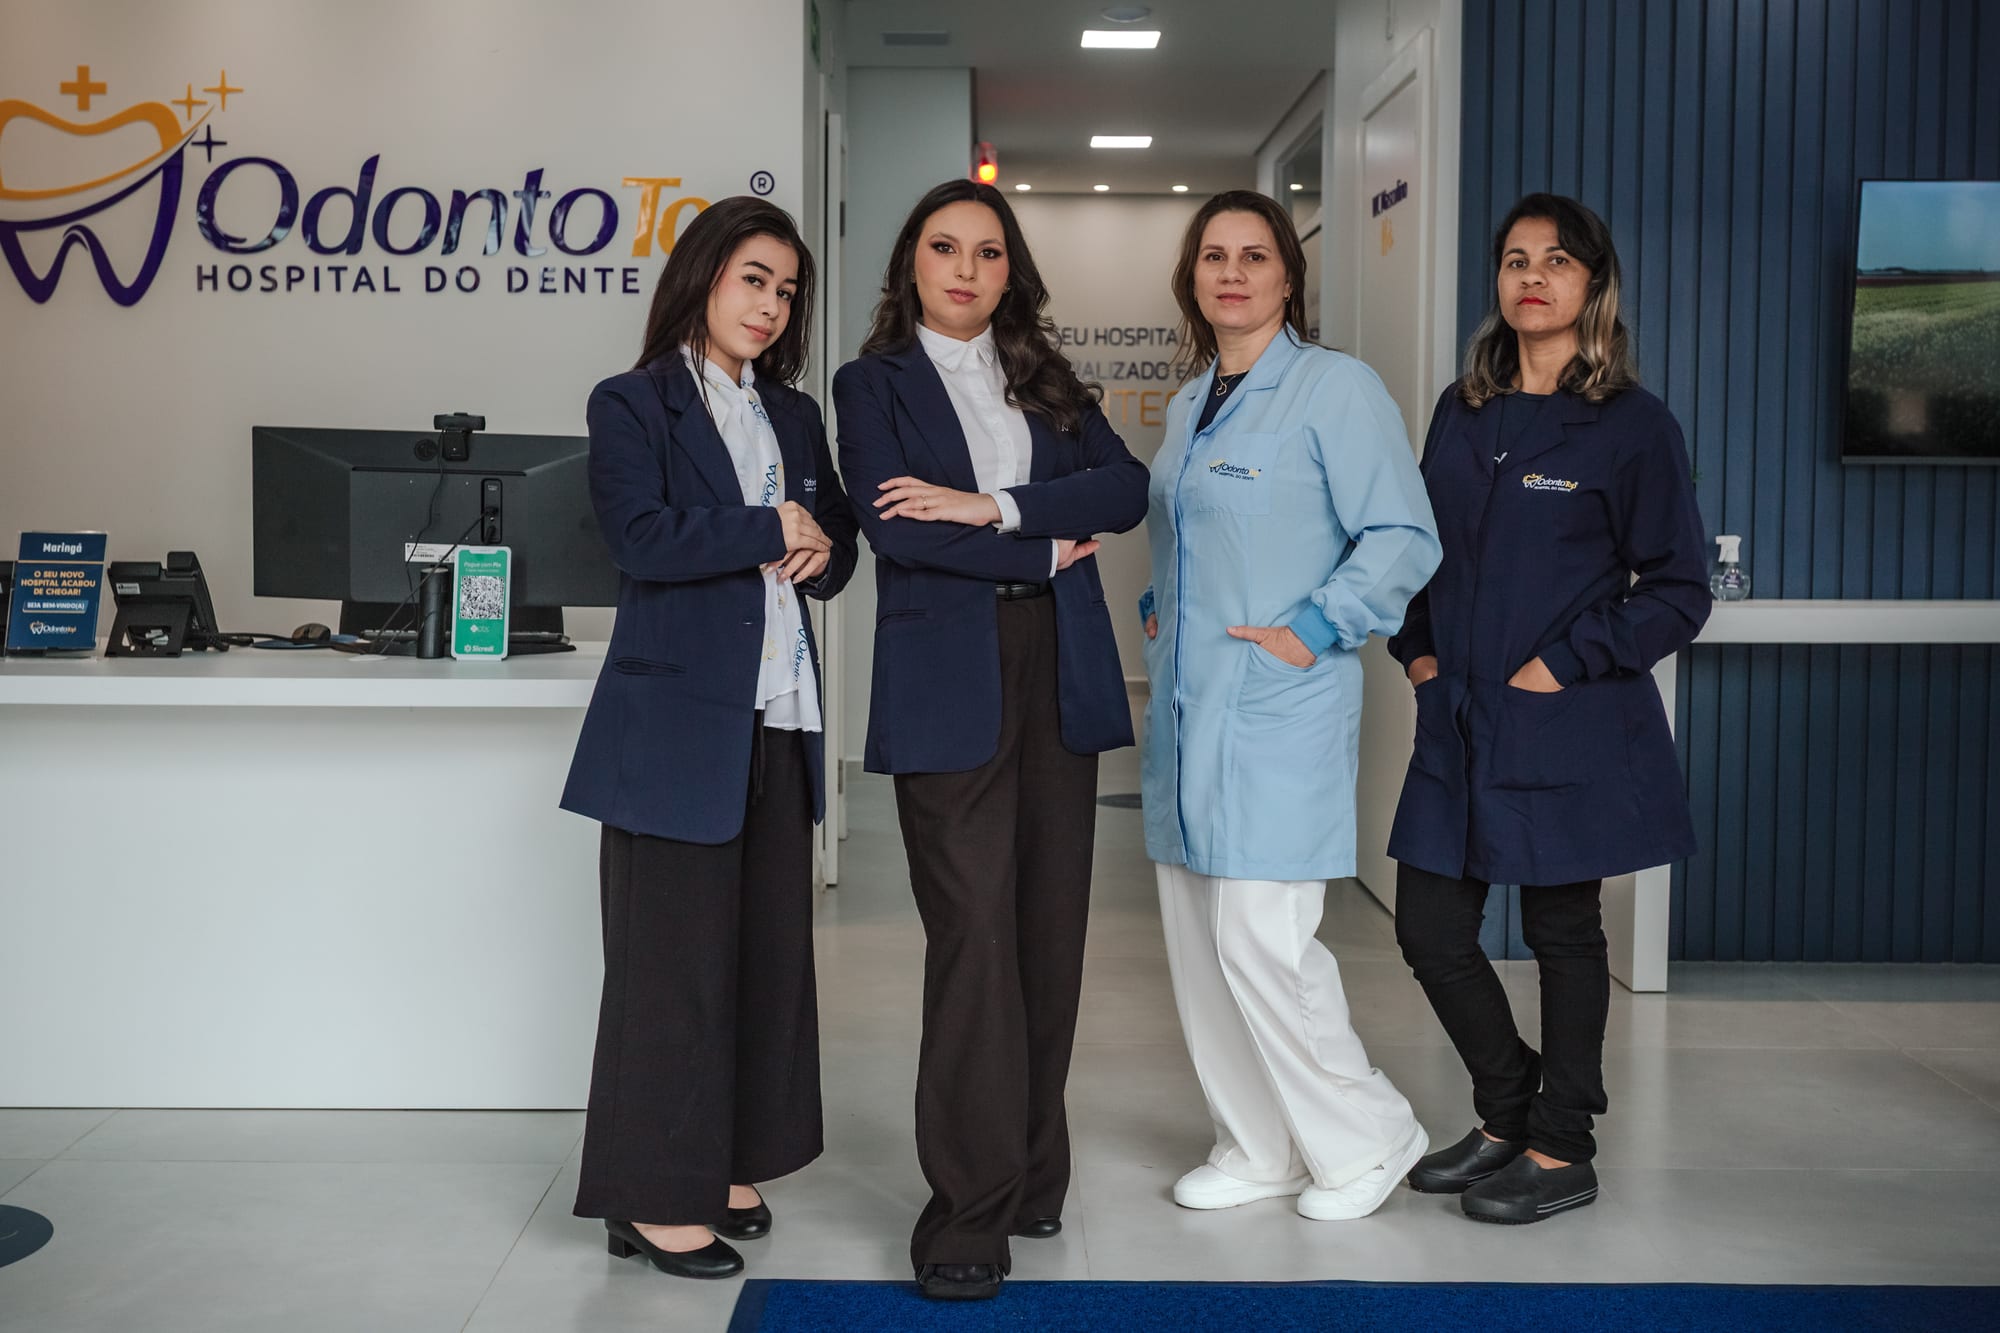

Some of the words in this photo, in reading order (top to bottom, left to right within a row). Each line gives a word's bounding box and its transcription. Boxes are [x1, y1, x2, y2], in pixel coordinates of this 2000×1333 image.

[196, 153, 712, 257] OdontoTo
[196, 264, 401, 293] HOSPITAL
[425, 265, 481, 293] DO
[507, 266, 640, 294] DENTE
[43, 542, 82, 555] Maringá
[43, 570, 58, 578] SEU
[46, 588, 81, 596] CHEGAR!
